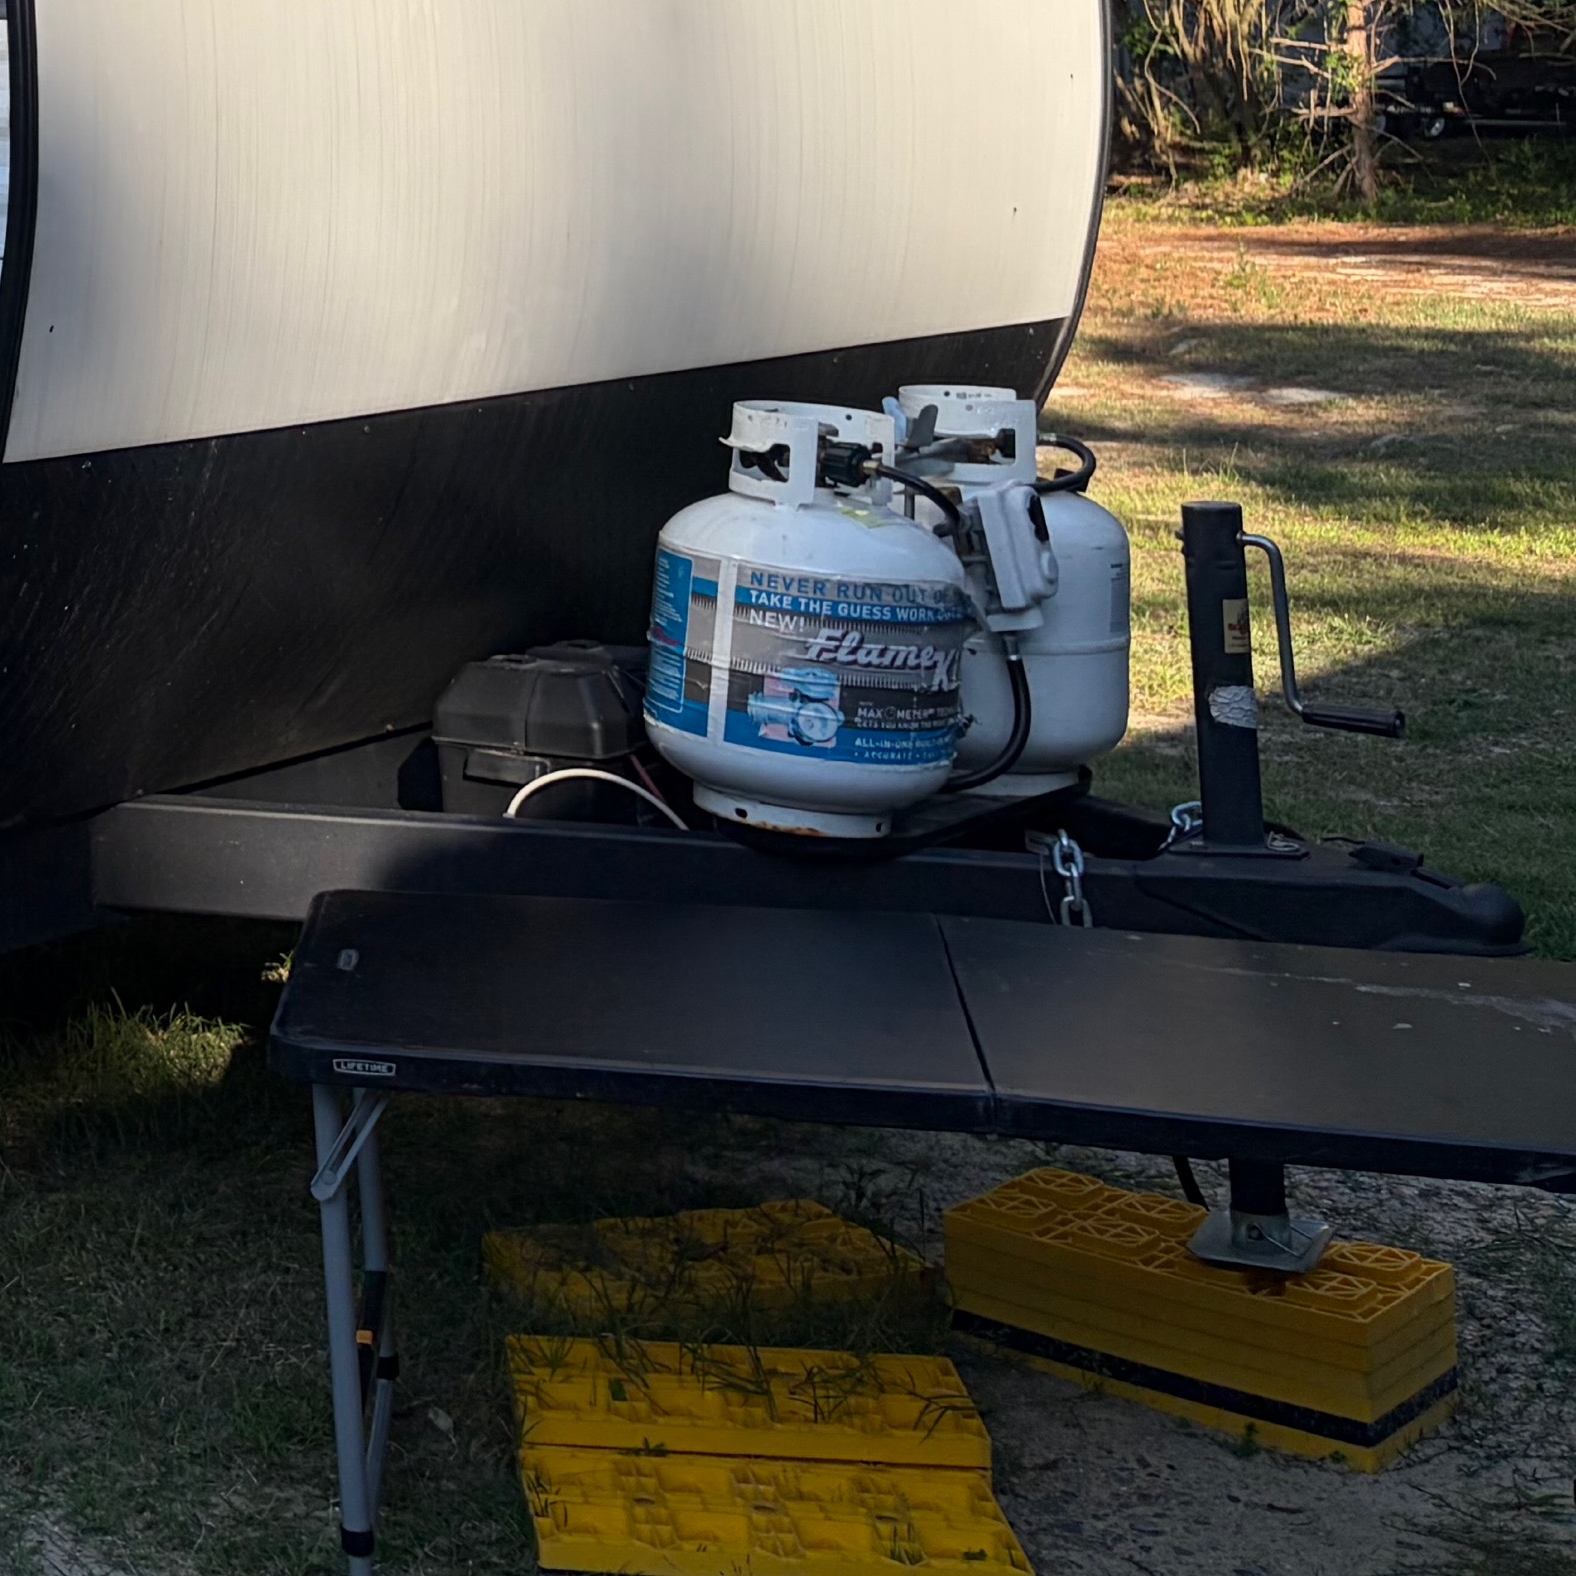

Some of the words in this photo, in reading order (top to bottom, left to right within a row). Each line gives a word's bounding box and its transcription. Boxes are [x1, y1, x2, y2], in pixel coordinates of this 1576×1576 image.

[750, 571, 826, 596] NEVER
[836, 580, 883, 602] RUN
[892, 584, 927, 604] OUT
[749, 590, 793, 608] TAKE
[798, 597, 832, 616] THE
[838, 603, 892, 620] GUESS
[896, 606, 935, 623] WORK
[749, 608, 805, 632] NEW!
